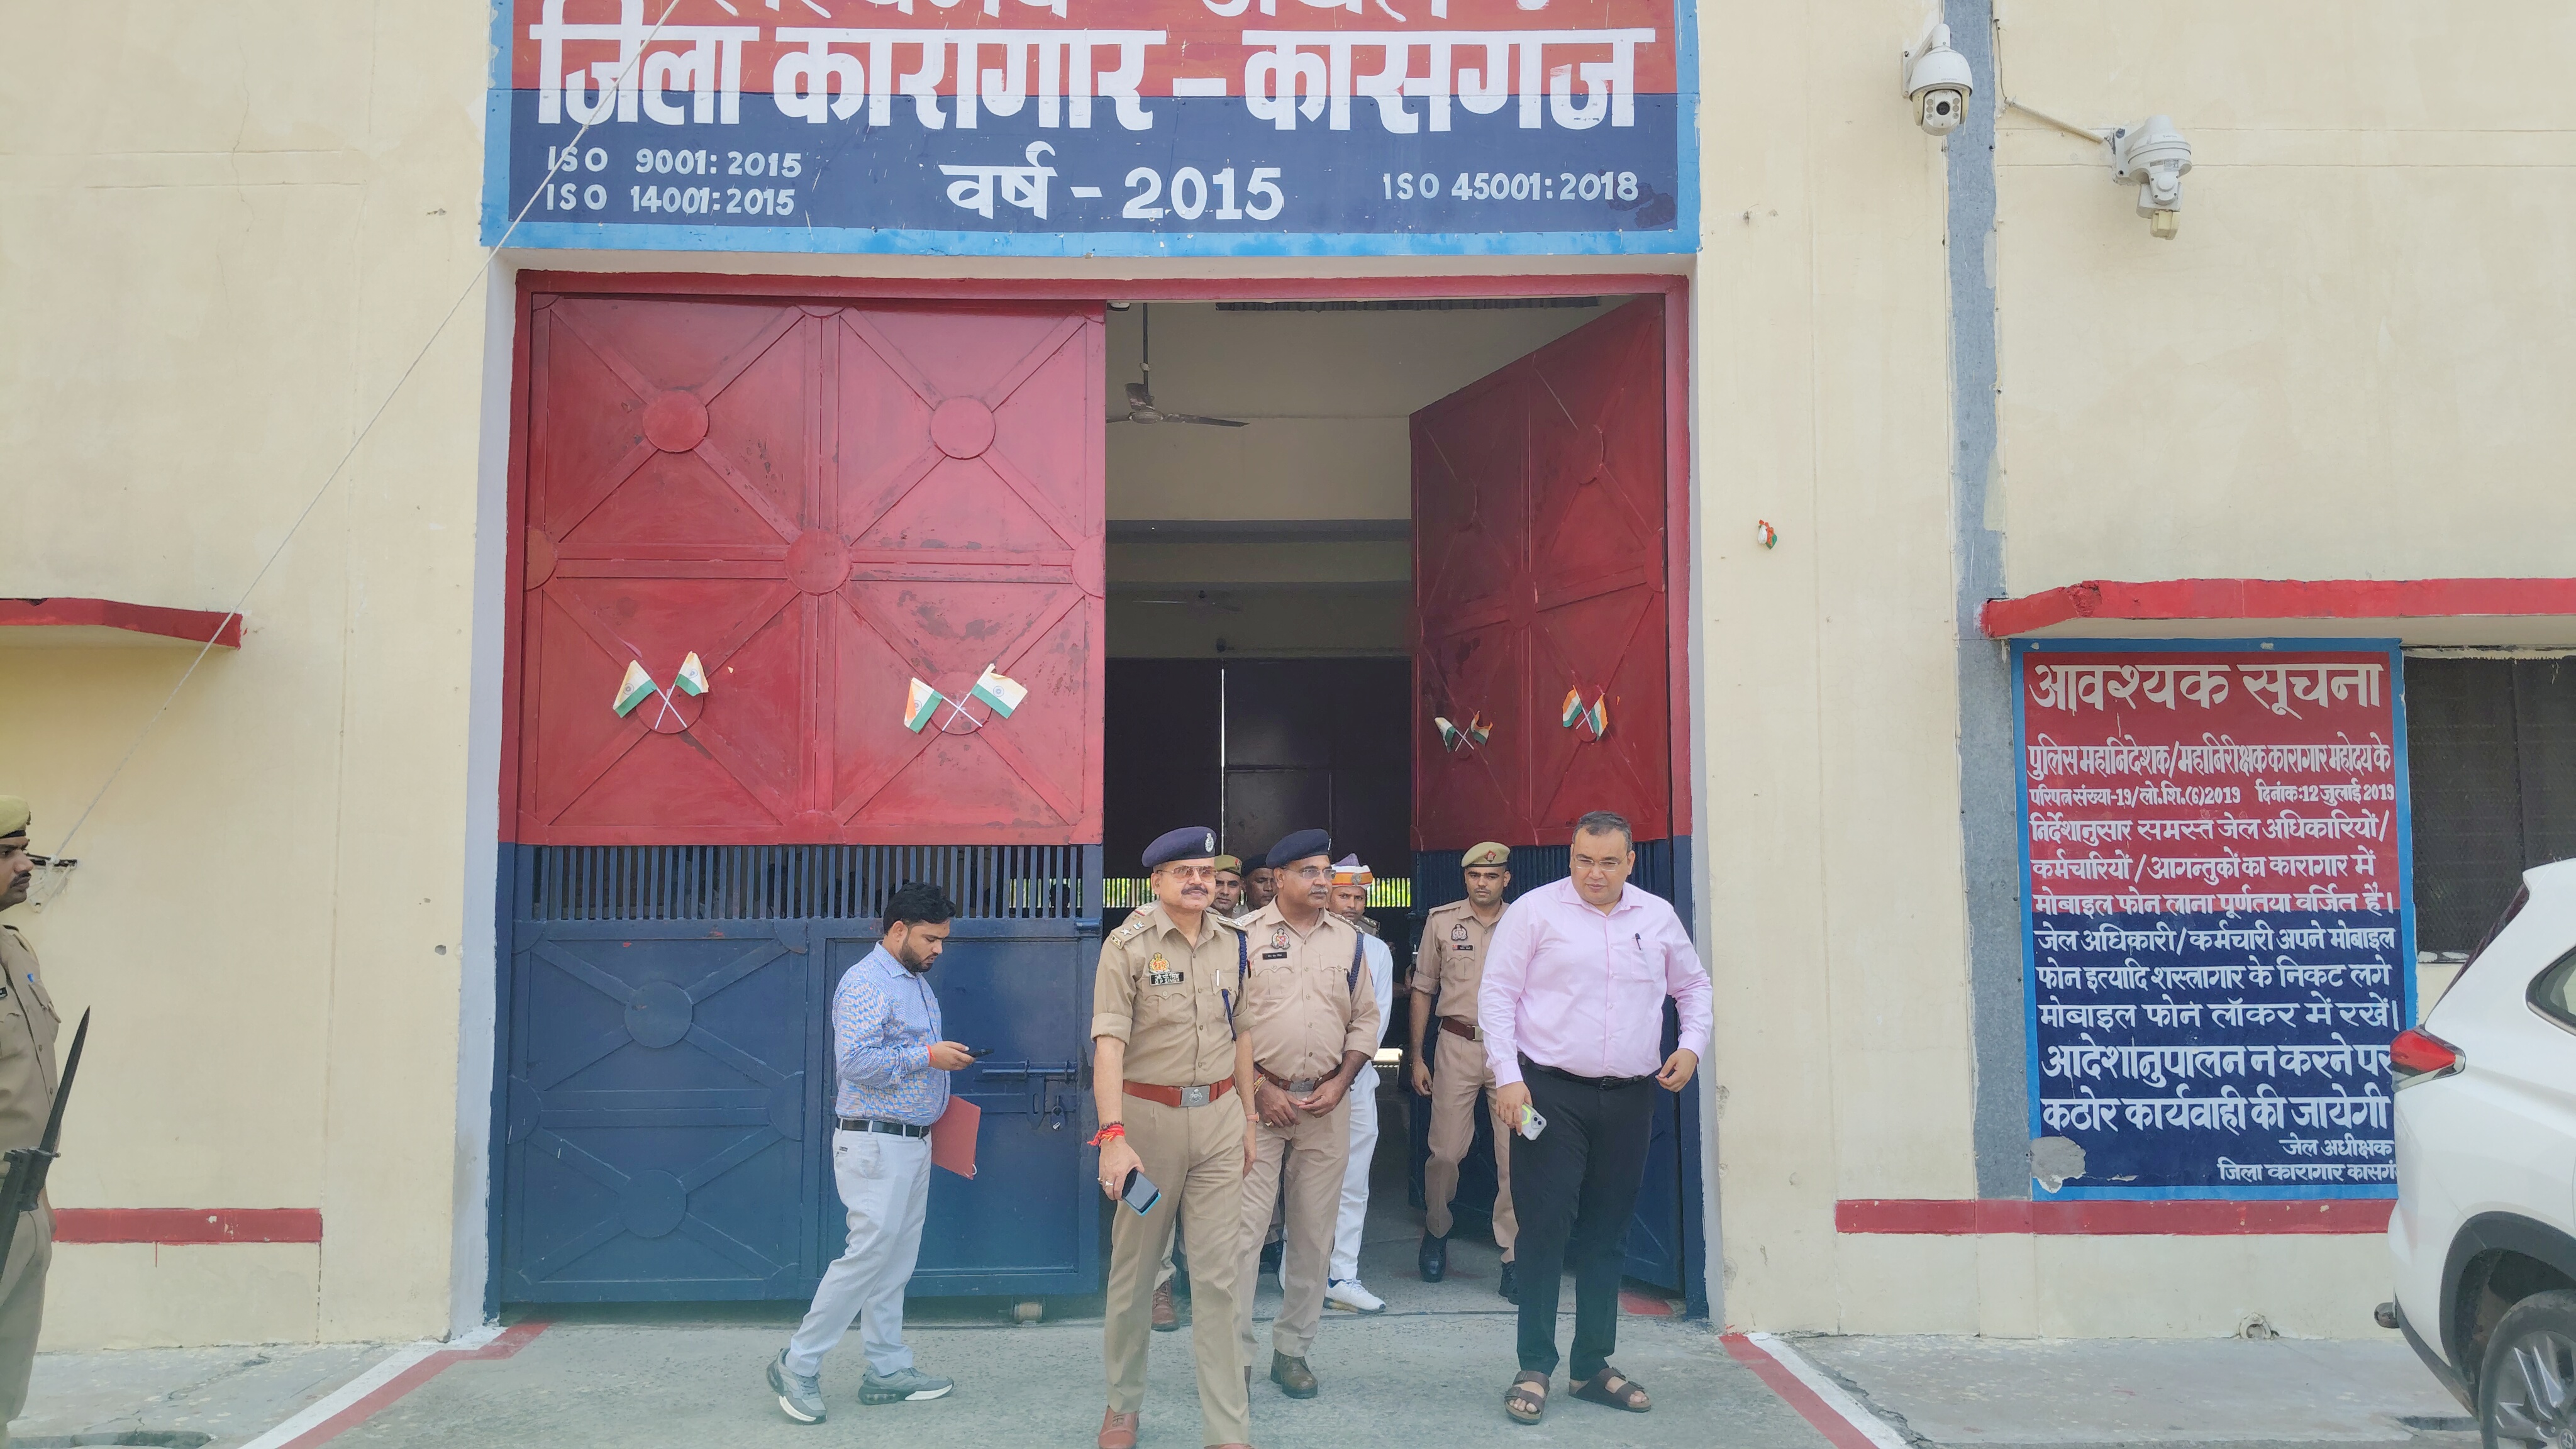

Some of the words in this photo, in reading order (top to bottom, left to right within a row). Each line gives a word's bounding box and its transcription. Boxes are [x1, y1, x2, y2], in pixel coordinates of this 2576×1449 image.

[530, 0, 759, 125] जिला
[773, 28, 1166, 131] कारागार
[547, 145, 608, 172] ISO
[728, 151, 802, 178] 2015
[547, 183, 608, 210] ISO
[938, 140, 1058, 219] वर्ष
[1123, 167, 1284, 219] 2015
[1383, 172, 1439, 200] ISO
[2028, 664, 2231, 711] आवश्यक
[2236, 664, 2384, 720] सूचना
[2028, 733, 2078, 779] पुलिस
[2267, 745, 2329, 775] कारागार
[2328, 732, 2372, 775] महोदय
[2370, 732, 2391, 772] के
[2319, 778, 2362, 806] जुलाई
[2363, 784, 2395, 801] 2019
[2028, 812, 2133, 846] निर्देशानुसार
[2136, 819, 2214, 841] समस्त
[2216, 811, 2261, 840] जेल
[2030, 849, 2133, 880] कर्मचारियों
[2242, 857, 2266, 878] का
[2269, 855, 2348, 878] कारागार
[2347, 846, 2375, 877] में
[2032, 886, 2113, 917] मोबाइल
[2114, 886, 2161, 914] फोन
[2162, 894, 2214, 915] लाना
[2216, 884, 2292, 919] पूर्णतया
[2294, 884, 2358, 913] वर्जित
[2033, 921, 2077, 953] जेल
[2275, 919, 2326, 952] अपने
[2326, 919, 2396, 953] मोबाइल
[2035, 957, 2081, 989] फोन
[2082, 958, 2150, 993] इत्यादि
[2246, 955, 2273, 987] के
[2275, 955, 2346, 987] निकट
[2349, 955, 2392, 987] लगे
[2038, 996, 2136, 1031] मोबाइल
[2207, 997, 2299, 1028] लॉकर
[2304, 992, 2333, 1028] में
[2041, 1033, 2247, 1087] आदेशानुपालन
[2247, 1046, 2276, 1078] न
[2278, 1033, 2352, 1079] करने
[2041, 1086, 2121, 1132] कठोर
[2121, 1084, 2248, 1135] कार्यवाही
[2247, 1083, 2287, 1130] की
[2288, 1082, 2391, 1130] जायेगी
[2280, 1133, 2318, 1158] जेल
[2217, 1157, 2263, 1182] जिला
[2264, 1163, 2346, 1182] कारागार
[2346, 1160, 2397, 1181] कासगं
